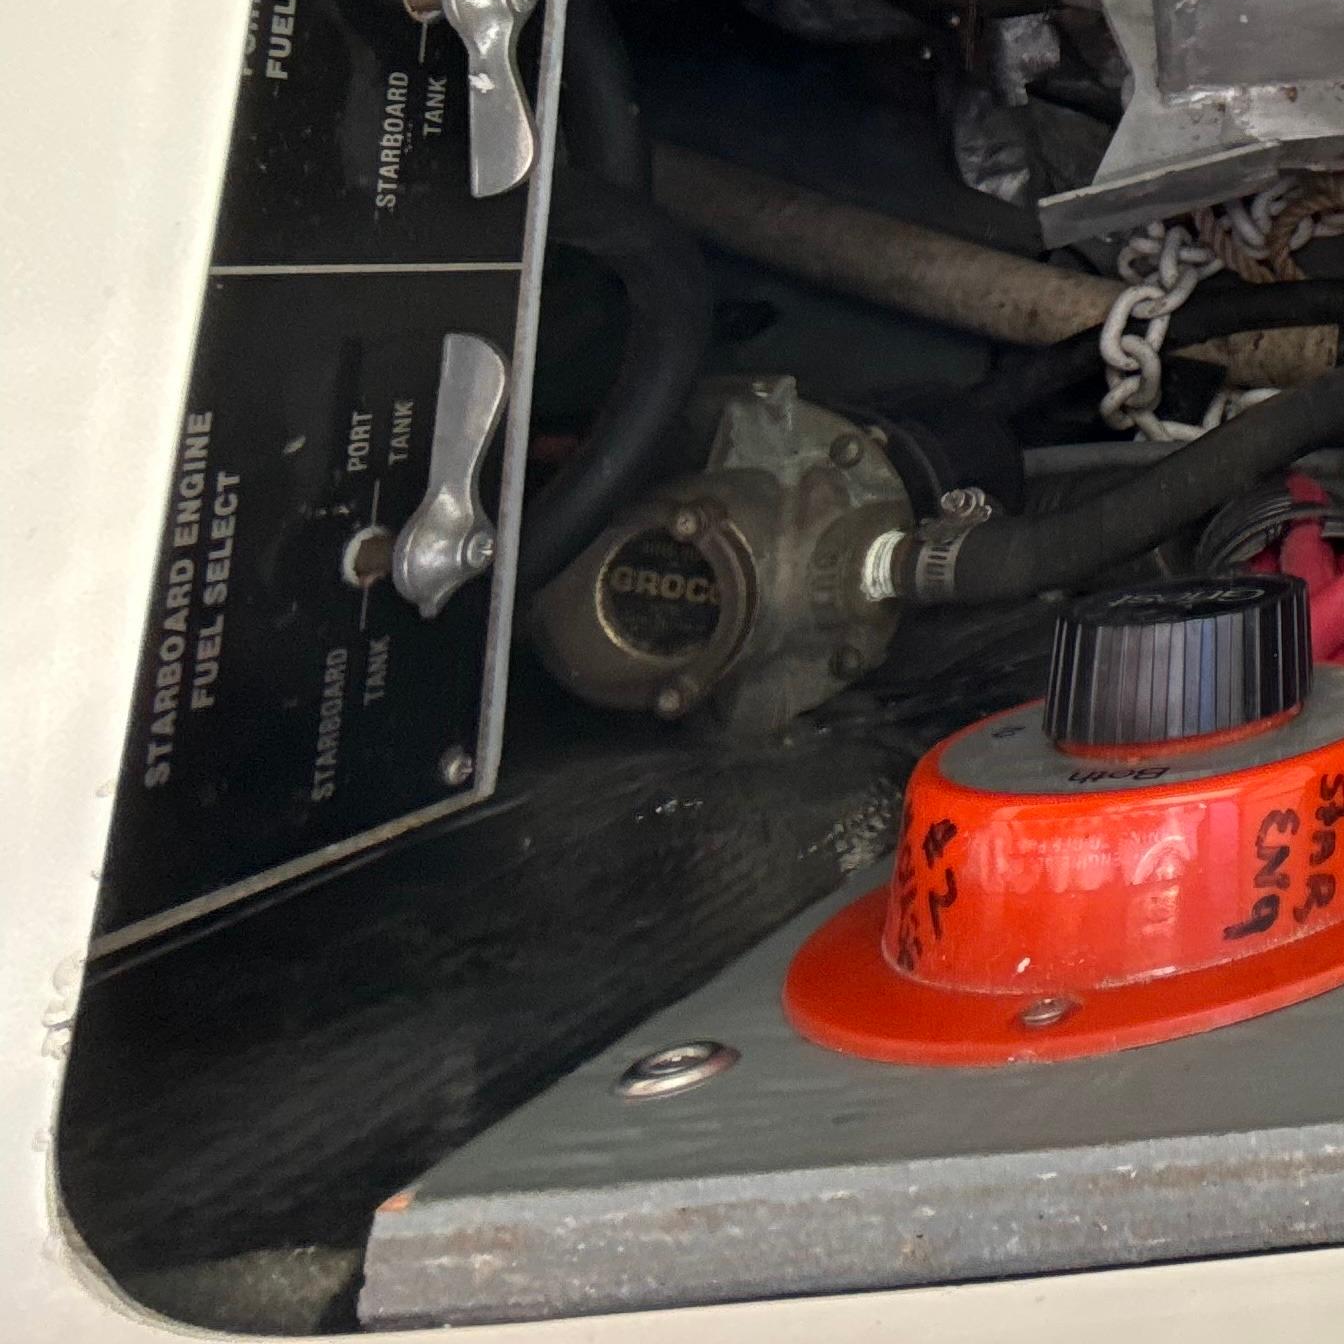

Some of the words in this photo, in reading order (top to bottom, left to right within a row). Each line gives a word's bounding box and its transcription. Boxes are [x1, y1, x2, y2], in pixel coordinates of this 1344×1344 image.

[376, 71, 409, 211] STARBOARD
[422, 76, 447, 137] TANK
[346, 410, 374, 472] PORT
[388, 399, 414, 467] TANK
[198, 470, 241, 604] SELECT
[145, 558, 195, 788] STARBOARD
[173, 411, 213, 548] ENGINE
[191, 613, 224, 711] FUEL
[362, 635, 391, 707] TANK
[311, 647, 348, 803] STARBOARD
[1067, 763, 1170, 786] Both
